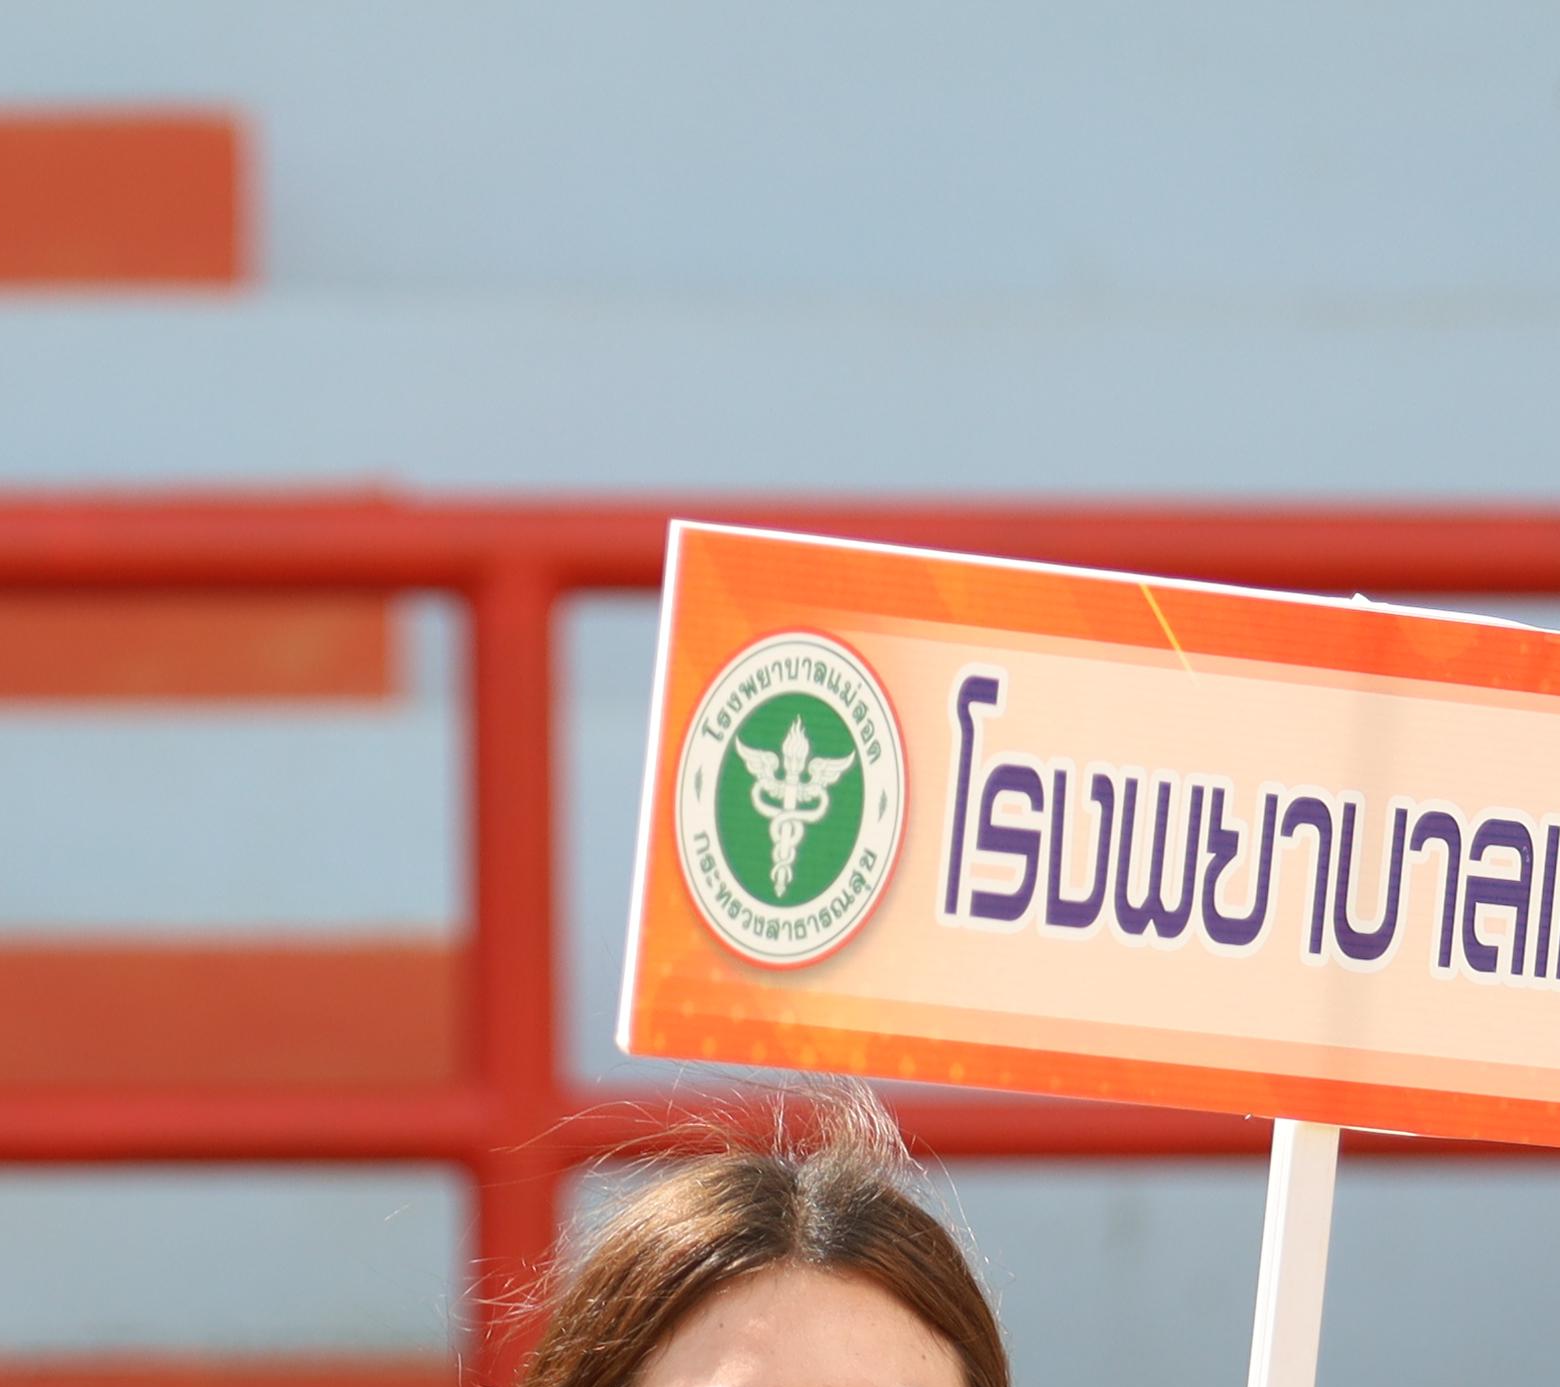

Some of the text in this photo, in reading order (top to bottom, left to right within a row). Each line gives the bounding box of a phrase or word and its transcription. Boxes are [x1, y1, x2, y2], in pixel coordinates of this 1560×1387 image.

[701, 656, 883, 767] โรงพยาบาลแม่สอด
[692, 831, 878, 943] กระทรวงสาธารณสุข
